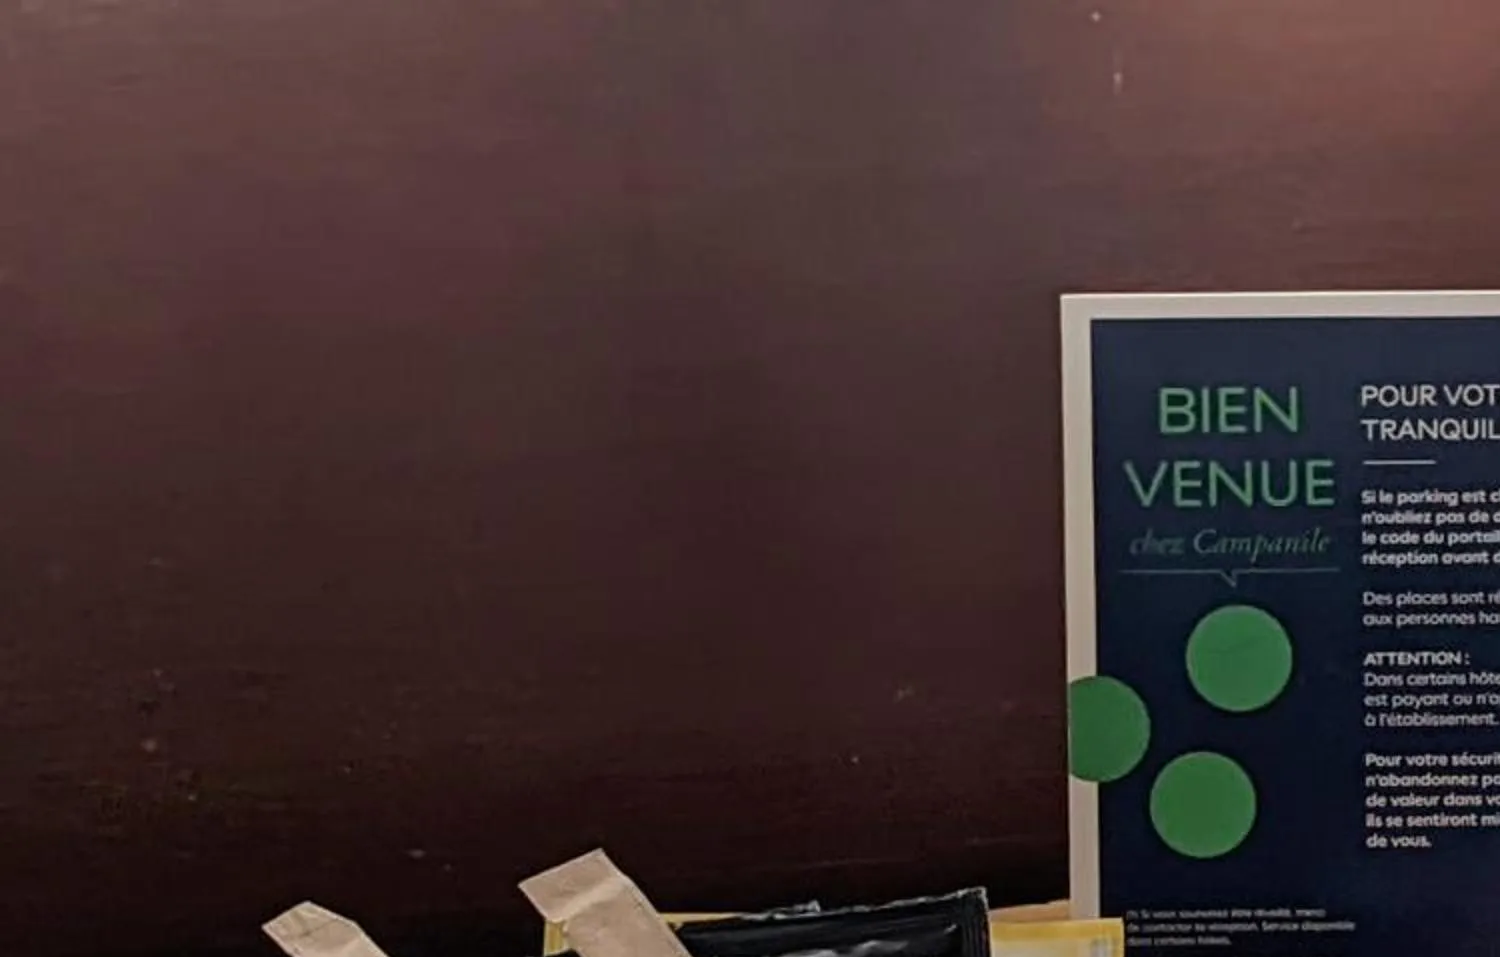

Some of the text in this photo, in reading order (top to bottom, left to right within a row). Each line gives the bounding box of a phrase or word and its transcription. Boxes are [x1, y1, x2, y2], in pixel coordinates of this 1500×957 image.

[1362, 384, 1436, 407] POUR
[1159, 386, 1299, 434] BIEN
[1122, 459, 1336, 508] VENUE
[1361, 490, 1377, 504] Si
[1396, 489, 1459, 507] parking
[1461, 489, 1487, 503] est
[1435, 513, 1465, 525] pas
[1468, 510, 1489, 523] de
[1129, 527, 1332, 563] chez Campanile
[1379, 531, 1420, 545] code
[1423, 531, 1445, 544] du
[1362, 550, 1439, 568] réception
[1441, 551, 1490, 565] avant
[1362, 592, 1394, 605] Des
[1395, 592, 1449, 608] places
[1450, 591, 1485, 604] sont
[1362, 615, 1393, 625] aux
[1395, 613, 1476, 628] personnes
[1363, 671, 1404, 686] Dans
[1363, 695, 1388, 706] est
[1392, 694, 1449, 709] payant
[1453, 696, 1473, 705] ou
[1365, 752, 1403, 766] Pour
[1405, 754, 1449, 766] votre
[1365, 773, 1478, 787] n'abandonnez
[1365, 793, 1387, 807] de
[1390, 793, 1440, 807] valeur
[1443, 792, 1483, 805] dans
[1385, 816, 1403, 827] se
[1407, 813, 1478, 826] sentiront
[1365, 833, 1432, 848] de vous.
